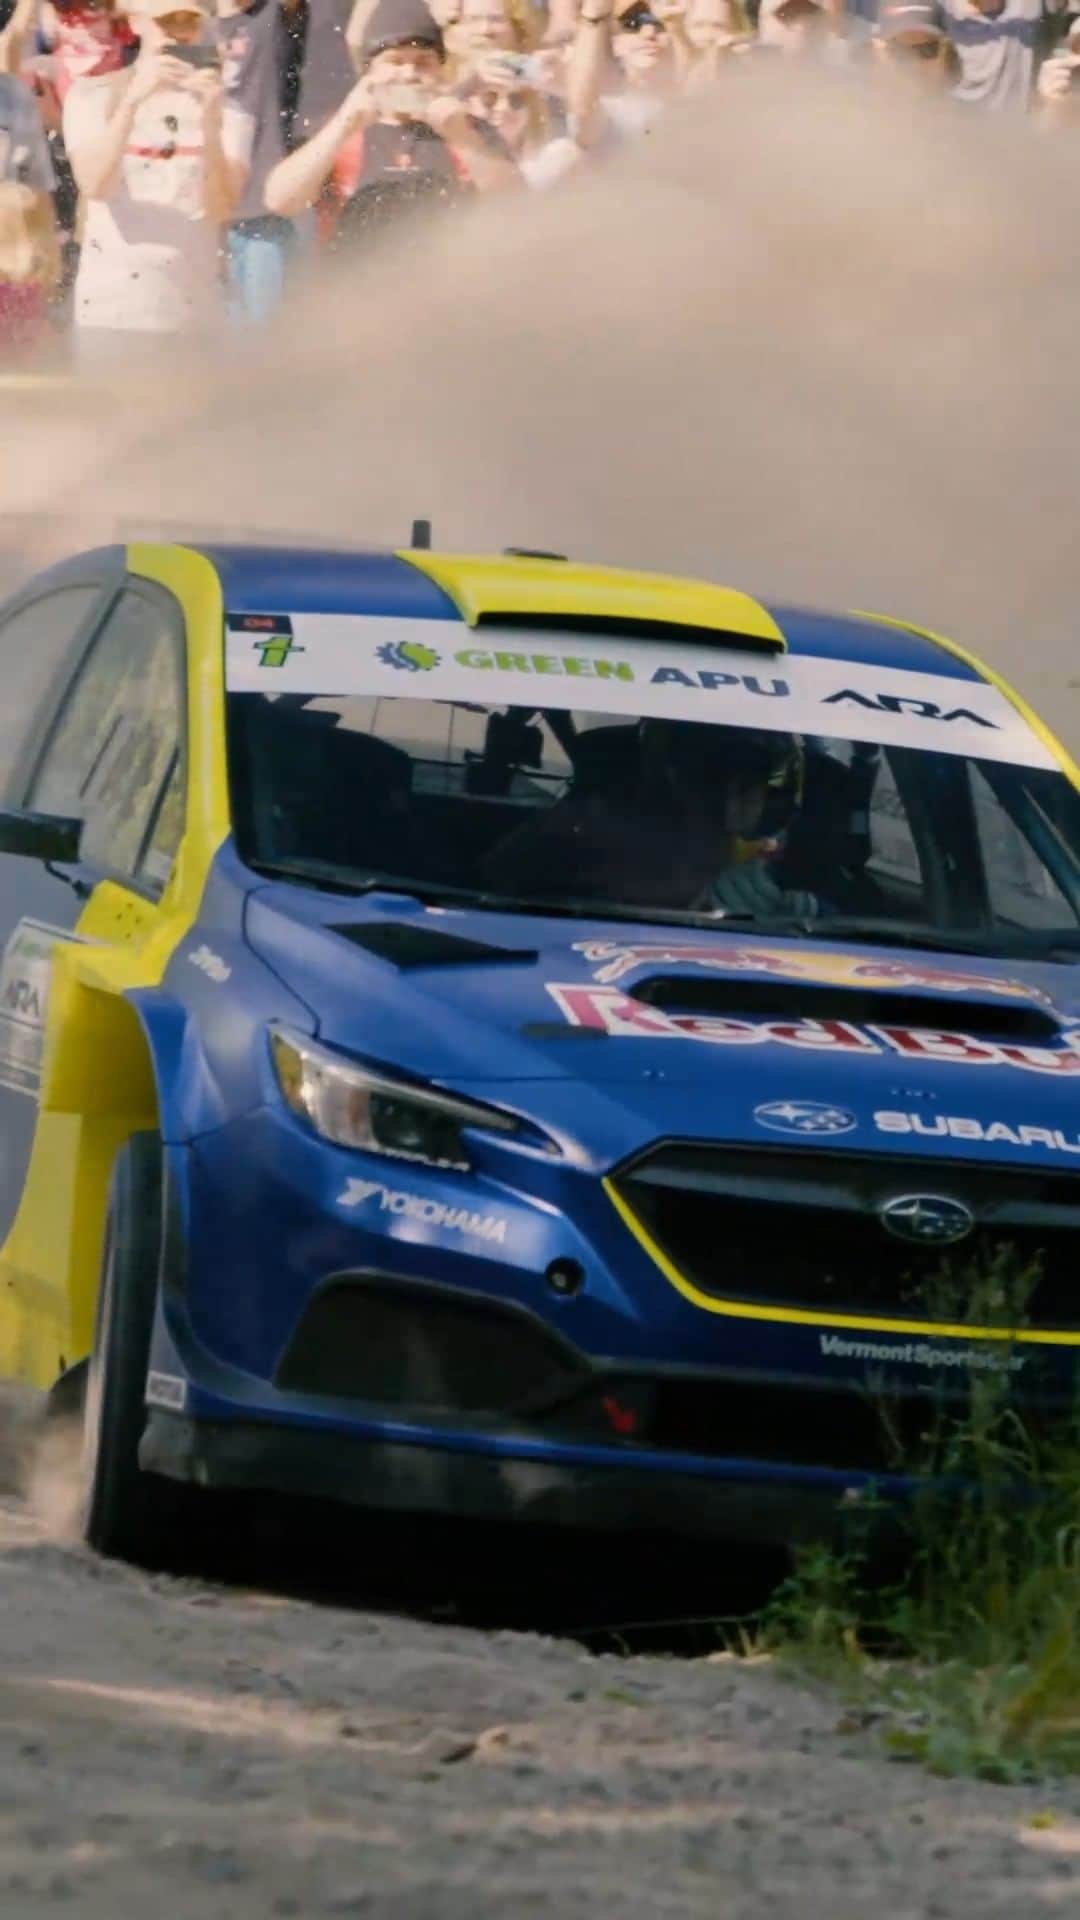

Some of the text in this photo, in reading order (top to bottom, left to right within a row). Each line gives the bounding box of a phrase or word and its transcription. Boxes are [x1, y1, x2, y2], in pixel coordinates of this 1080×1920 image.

[453, 647, 791, 697] GREEN APU
[819, 688, 1002, 730] ARA
[873, 1110, 1080, 1154] SUBARU
[379, 1187, 508, 1244] YOKOHAMA
